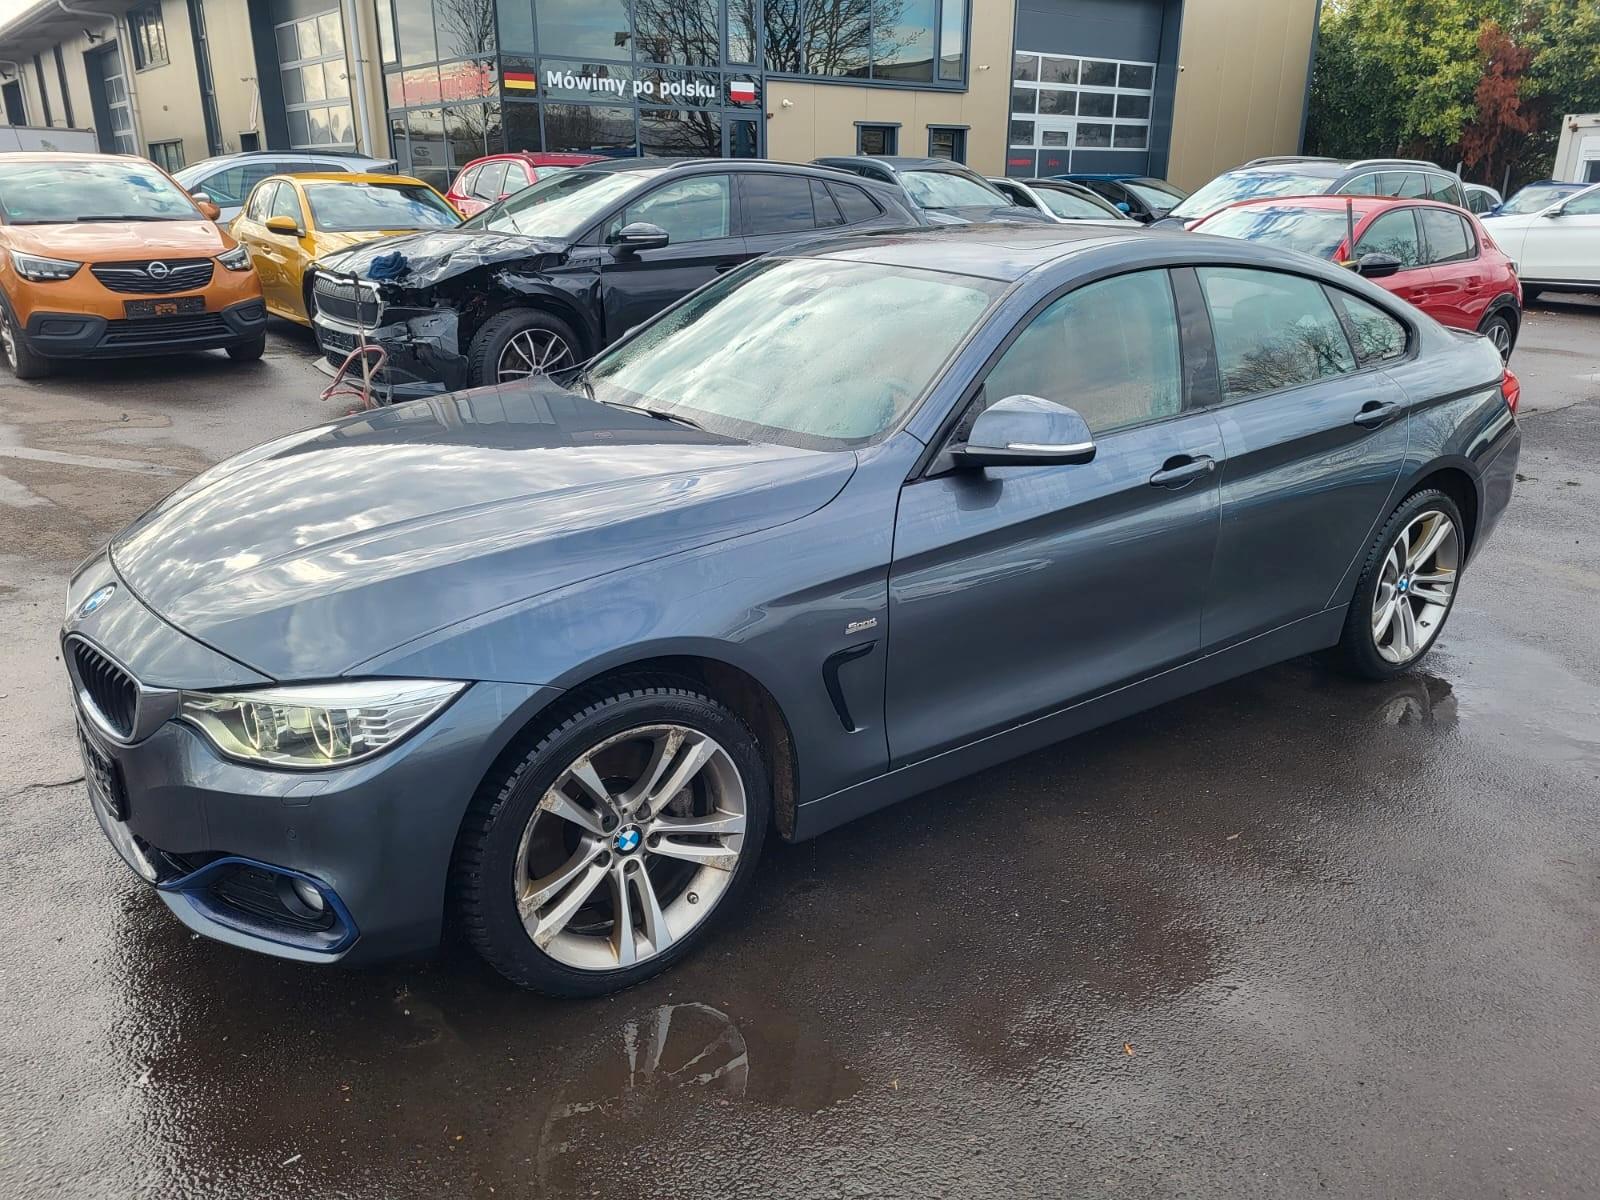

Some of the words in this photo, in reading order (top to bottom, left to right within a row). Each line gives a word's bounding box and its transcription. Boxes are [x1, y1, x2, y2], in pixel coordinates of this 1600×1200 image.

[547, 70, 627, 97] Mówimy
[633, 80, 655, 98] po
[659, 80, 716, 99] polsku
